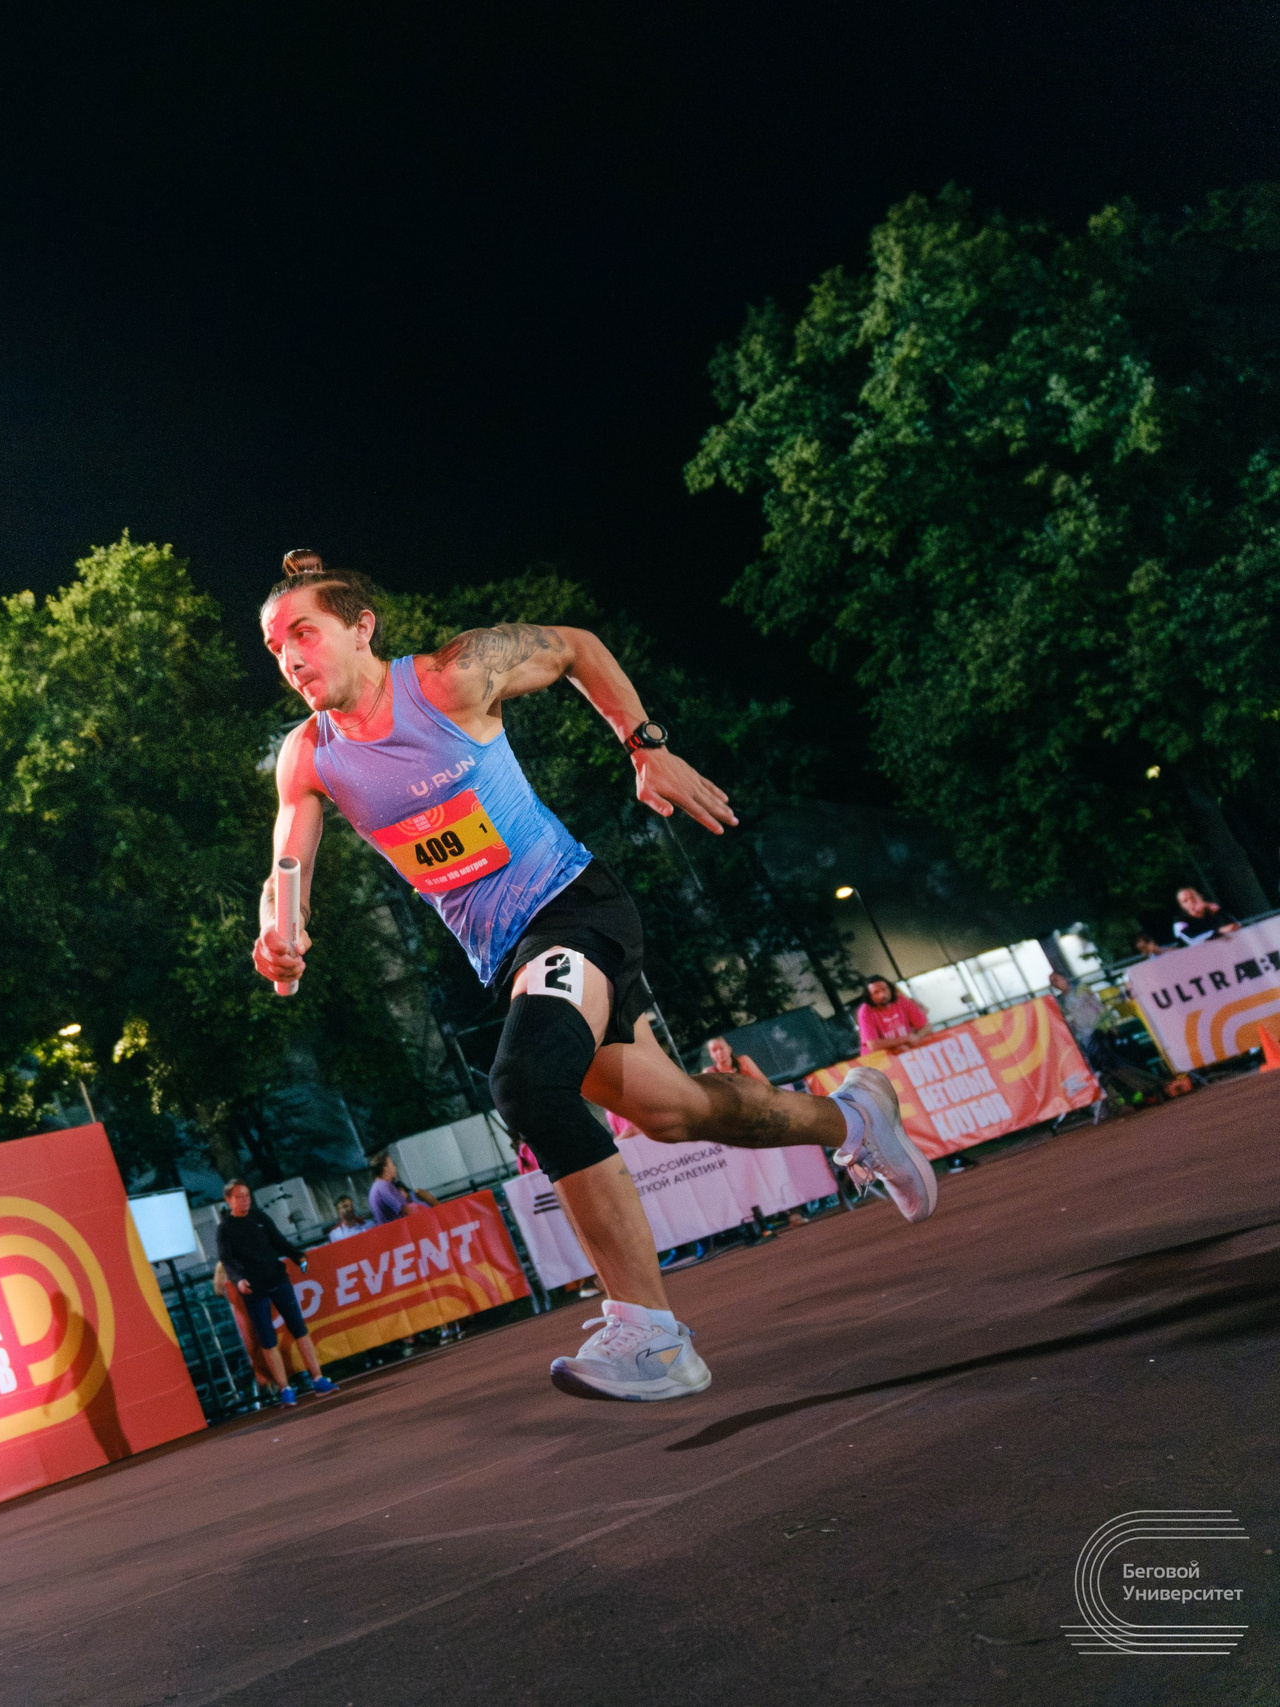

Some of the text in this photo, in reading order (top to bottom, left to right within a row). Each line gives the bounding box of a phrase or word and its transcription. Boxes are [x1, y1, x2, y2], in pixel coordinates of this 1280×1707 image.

[431, 755, 476, 788] RUN
[414, 830, 465, 867] 409
[478, 823, 488, 834] 1
[447, 870, 460, 881] 100
[459, 858, 488, 876] метров
[544, 953, 572, 993] 2
[898, 1032, 985, 1087] БИТВА
[915, 1066, 998, 1113] БЕГОВЫХ
[929, 1092, 1013, 1142] КЛУБОВ
[631, 1143, 723, 1184] СЕРОССИЙСКАЯ
[673, 1158, 728, 1184] АТЛЕТИКИ
[336, 1220, 480, 1306] EVENT
